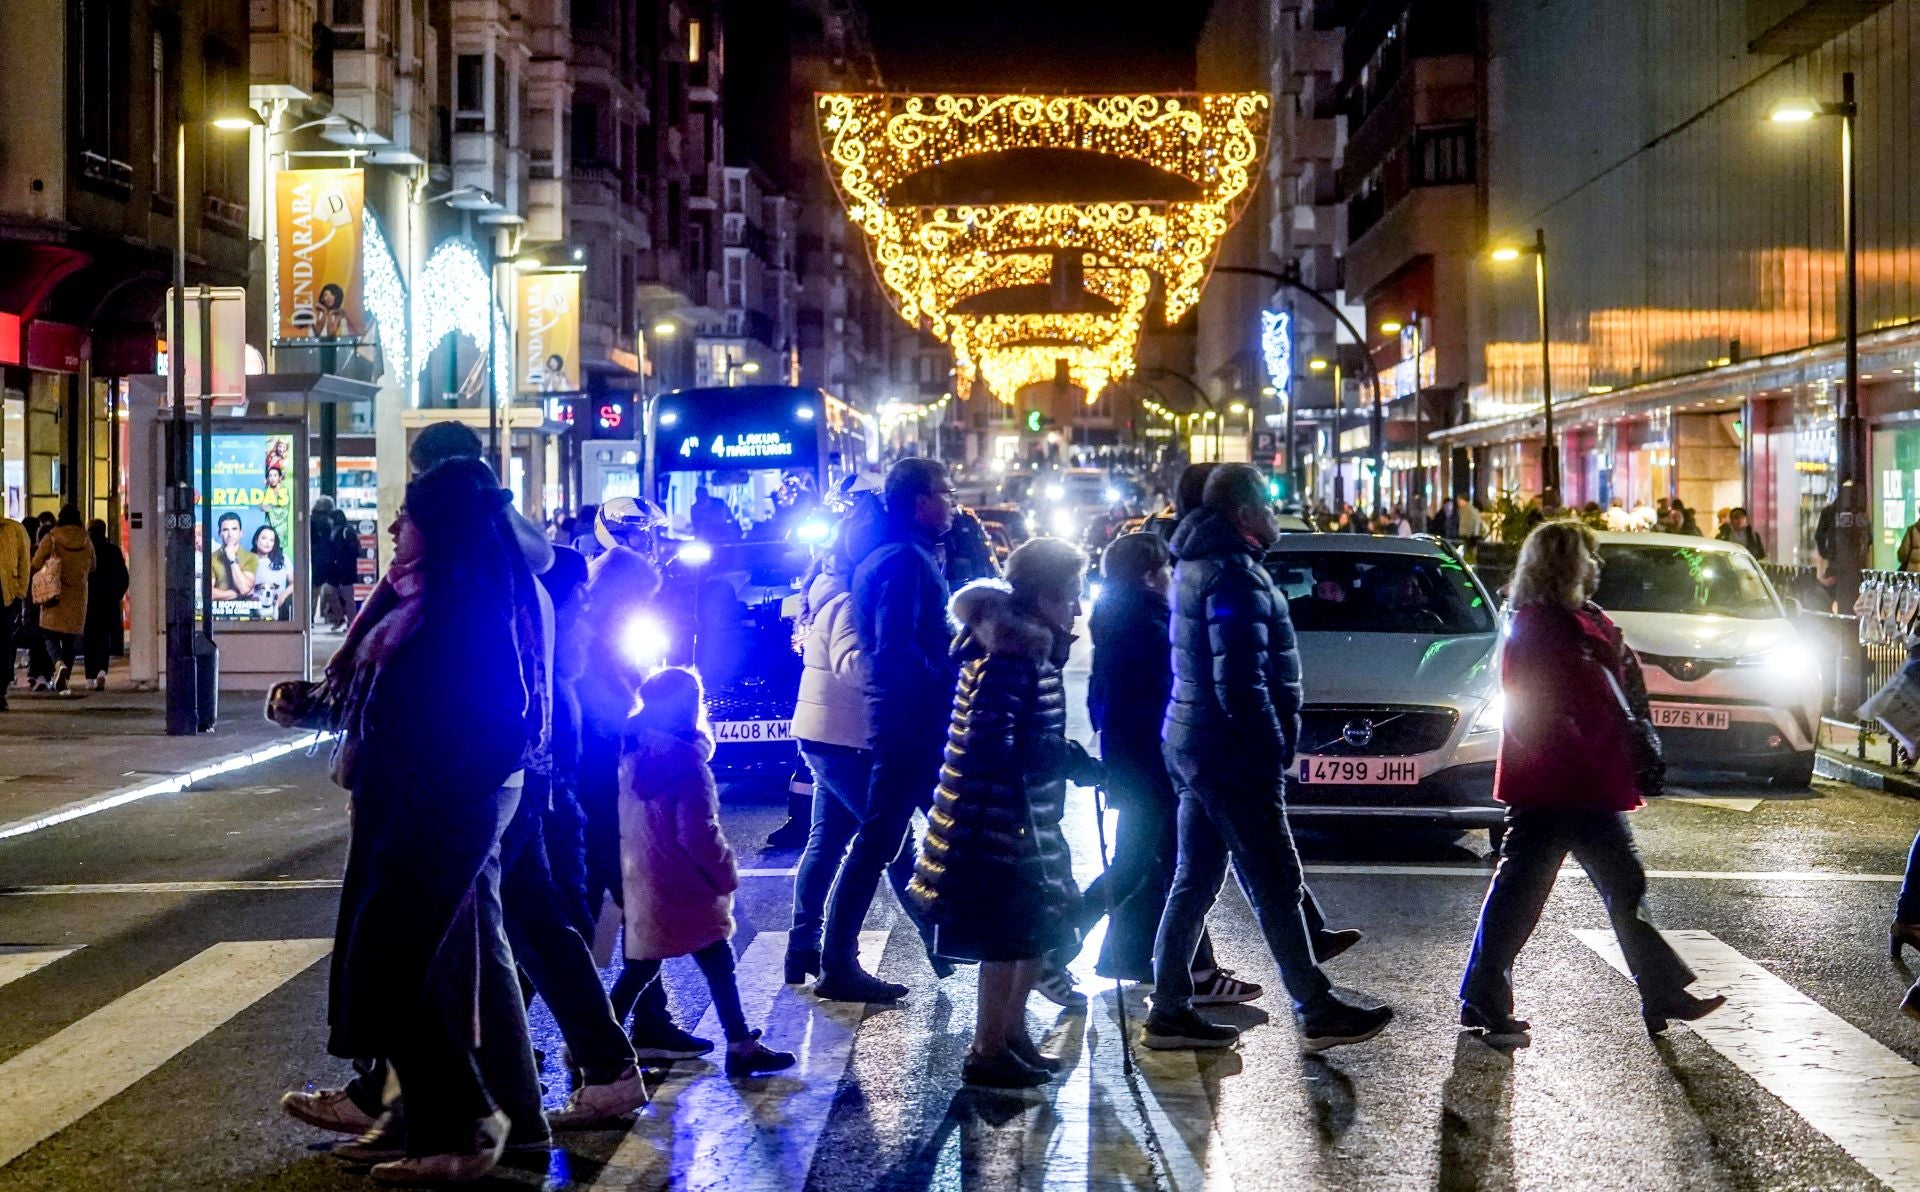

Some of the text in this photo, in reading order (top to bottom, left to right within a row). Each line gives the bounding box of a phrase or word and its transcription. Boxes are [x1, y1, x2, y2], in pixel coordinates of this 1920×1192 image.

[328, 195, 344, 214] D
[291, 182, 316, 327] DENDARABA
[526, 284, 545, 385] DENDARABA
[711, 434, 726, 458] 4
[737, 432, 781, 447] LAKUA
[1654, 709, 1691, 725] 1876
[719, 723, 761, 740] 4408
[1314, 761, 1368, 781] 4799
[1376, 761, 1415, 781] JHH
